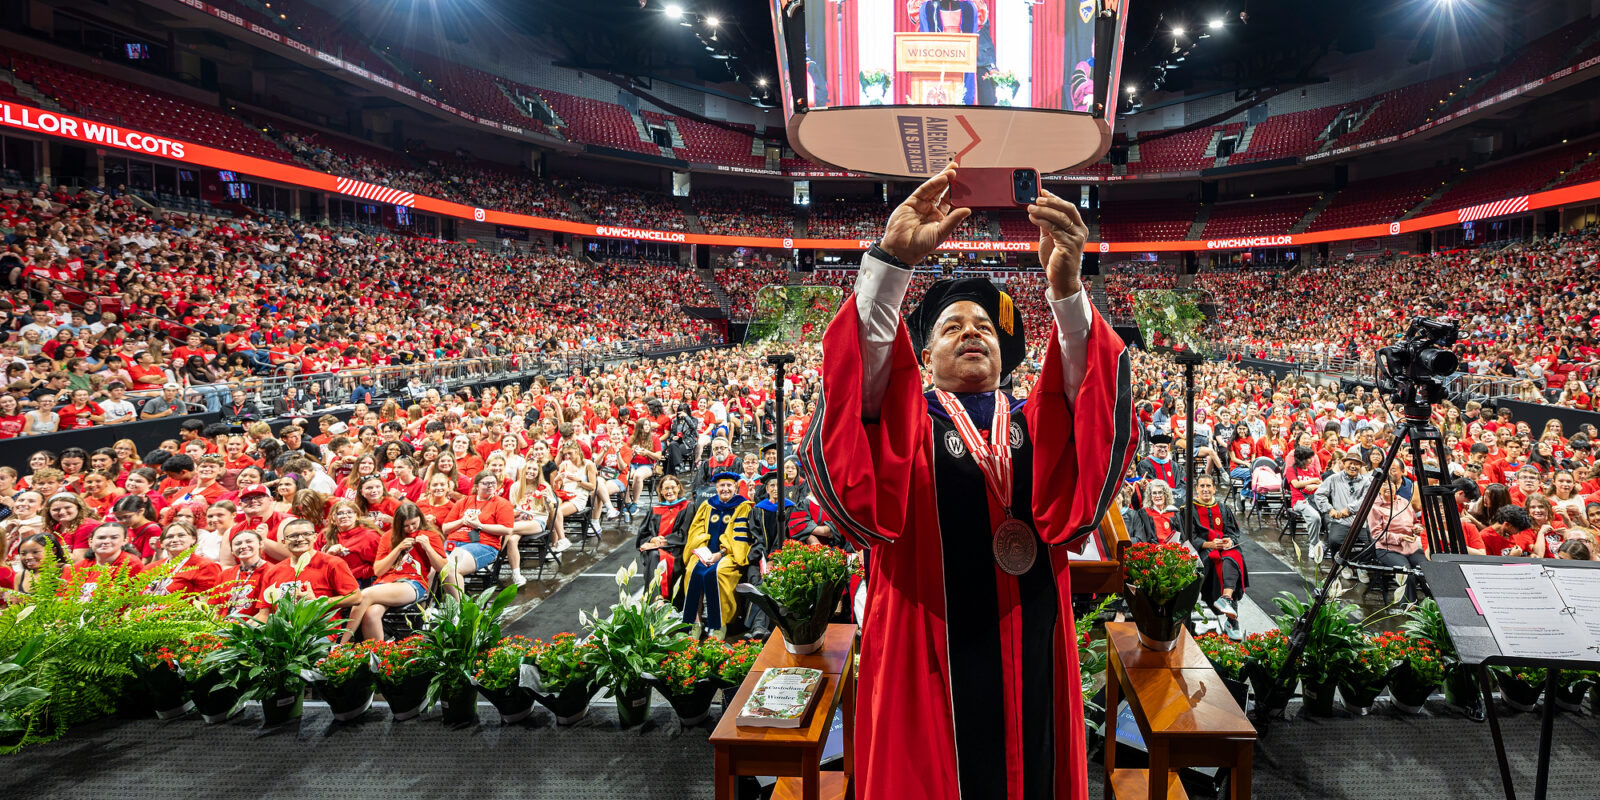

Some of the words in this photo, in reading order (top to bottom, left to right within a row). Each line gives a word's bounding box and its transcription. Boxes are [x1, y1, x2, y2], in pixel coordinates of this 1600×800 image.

[907, 48, 966, 59] WISCONSIN
[213, 8, 243, 26] 1998
[252, 25, 280, 41] 2000
[287, 38, 311, 54] 2001
[318, 52, 343, 66] 2004
[420, 94, 437, 105] 2010
[460, 111, 475, 121] 2014
[480, 118, 499, 128] 2021
[502, 124, 523, 134] 2024
[0, 103, 78, 137] LLOR
[82, 122, 185, 158] WILCOTS
[926, 116, 948, 157] AMERICAN
[903, 122, 924, 172] INSURANCE
[1305, 151, 1330, 161] FROZEN
[1333, 146, 1351, 155] FOUR
[1359, 141, 1376, 149] 1970
[596, 226, 685, 242] @UWCHANCELLOR
[1207, 236, 1292, 249] @UWCHANCELLOR
[937, 241, 991, 250] HANCELLOR
[992, 242, 1030, 250] WILCOTS
